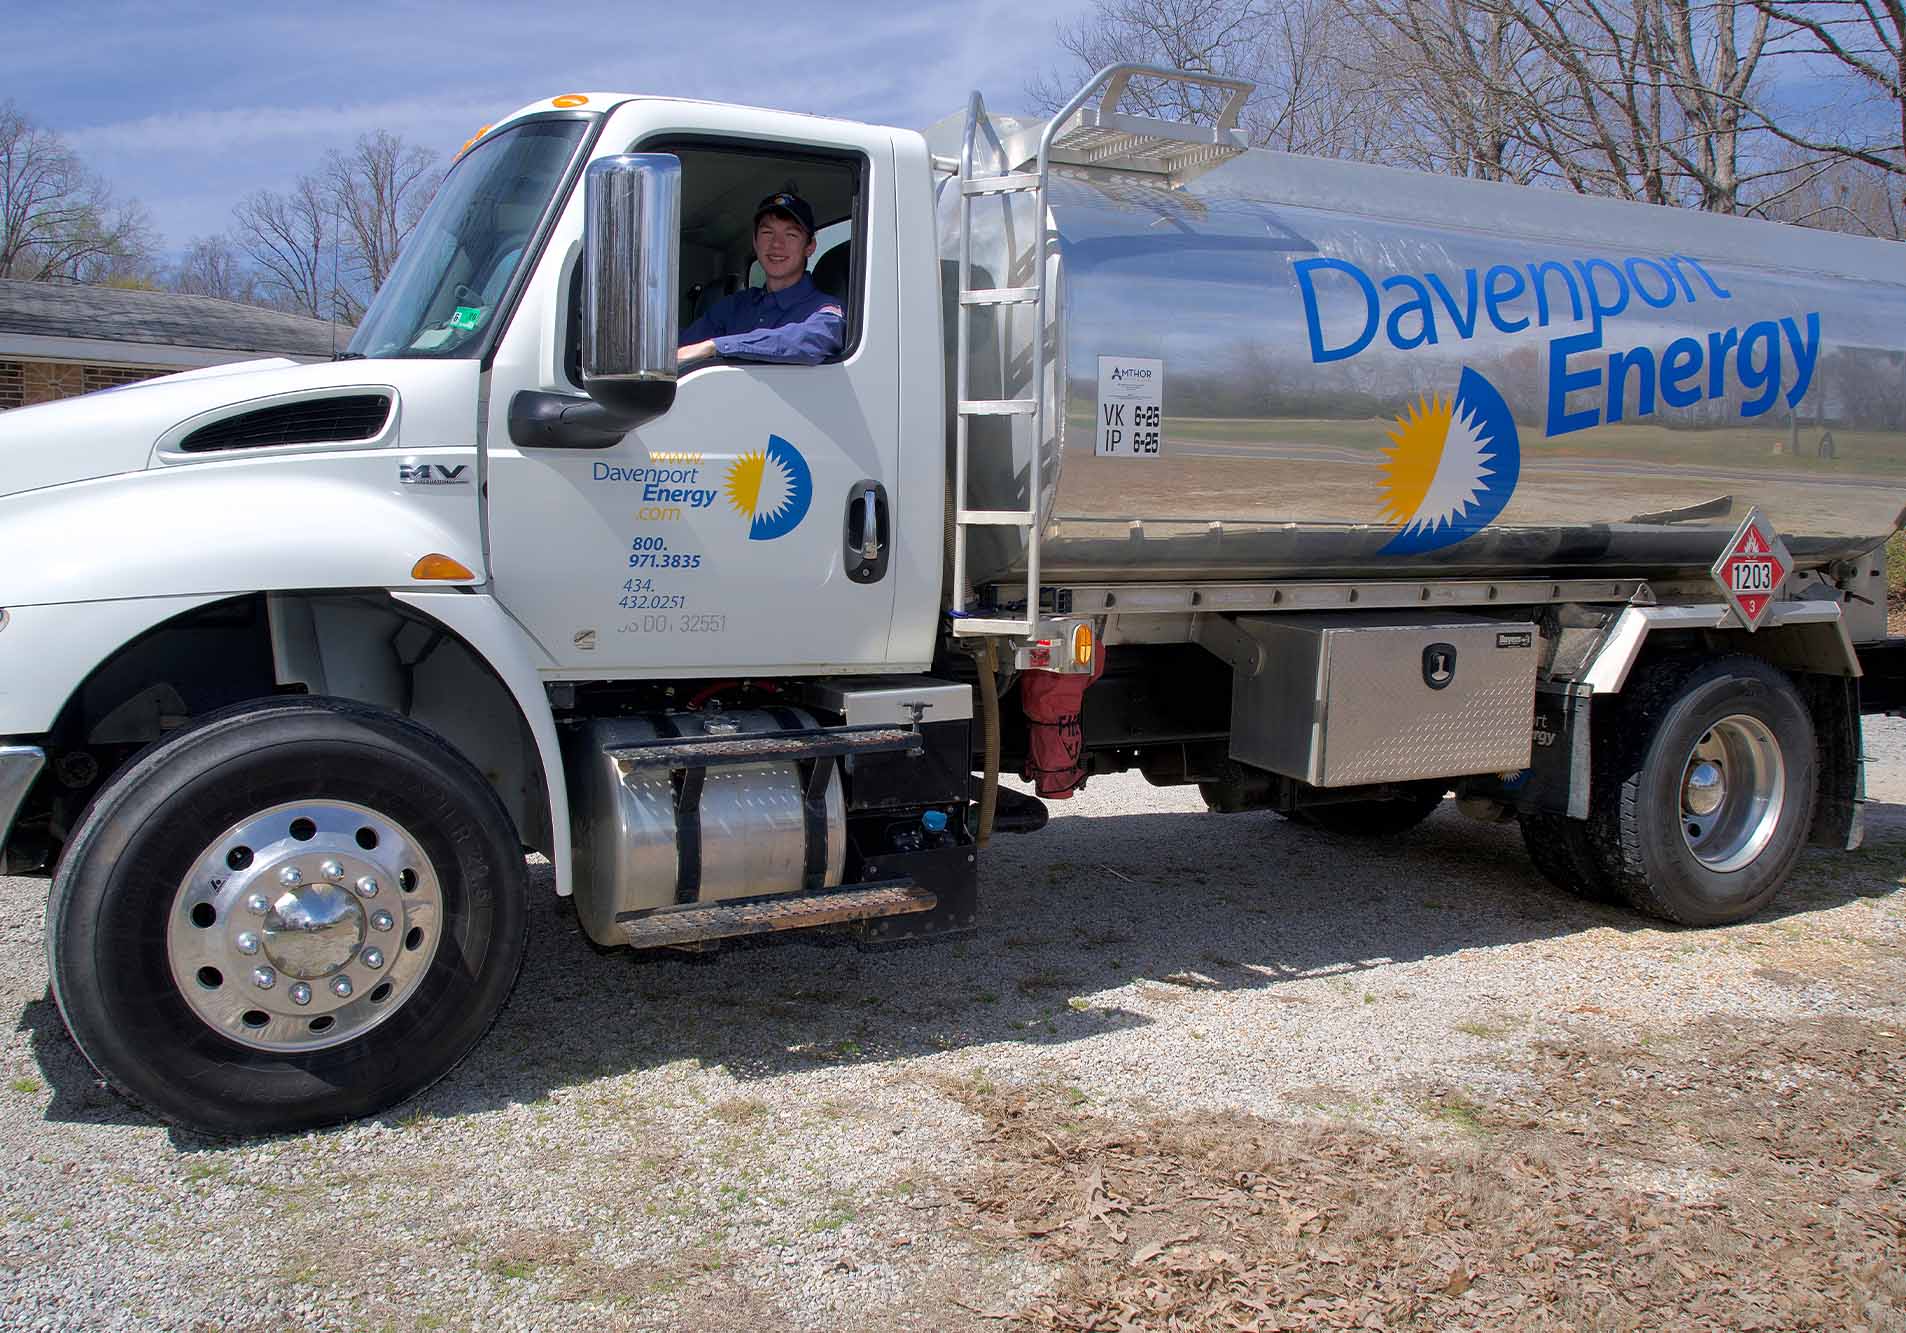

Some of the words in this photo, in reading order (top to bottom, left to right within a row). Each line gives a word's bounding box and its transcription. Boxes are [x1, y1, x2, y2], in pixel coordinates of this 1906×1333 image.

[1293, 254, 1731, 363] Davenport
[1545, 312, 1821, 438] Energy
[1103, 403, 1125, 427] VK
[1134, 405, 1160, 428] 6-25
[1105, 429, 1122, 452] IP
[1133, 432, 1159, 454] 6-25
[399, 464, 469, 479] MV
[592, 461, 699, 485] Davenport
[642, 483, 719, 508] Energy
[632, 536, 668, 551] 800.
[628, 554, 701, 568] 971.3835
[623, 578, 655, 593] 434.
[1734, 564, 1771, 589] 1203
[618, 595, 685, 609] 432.0251
[1749, 600, 1756, 612] 3
